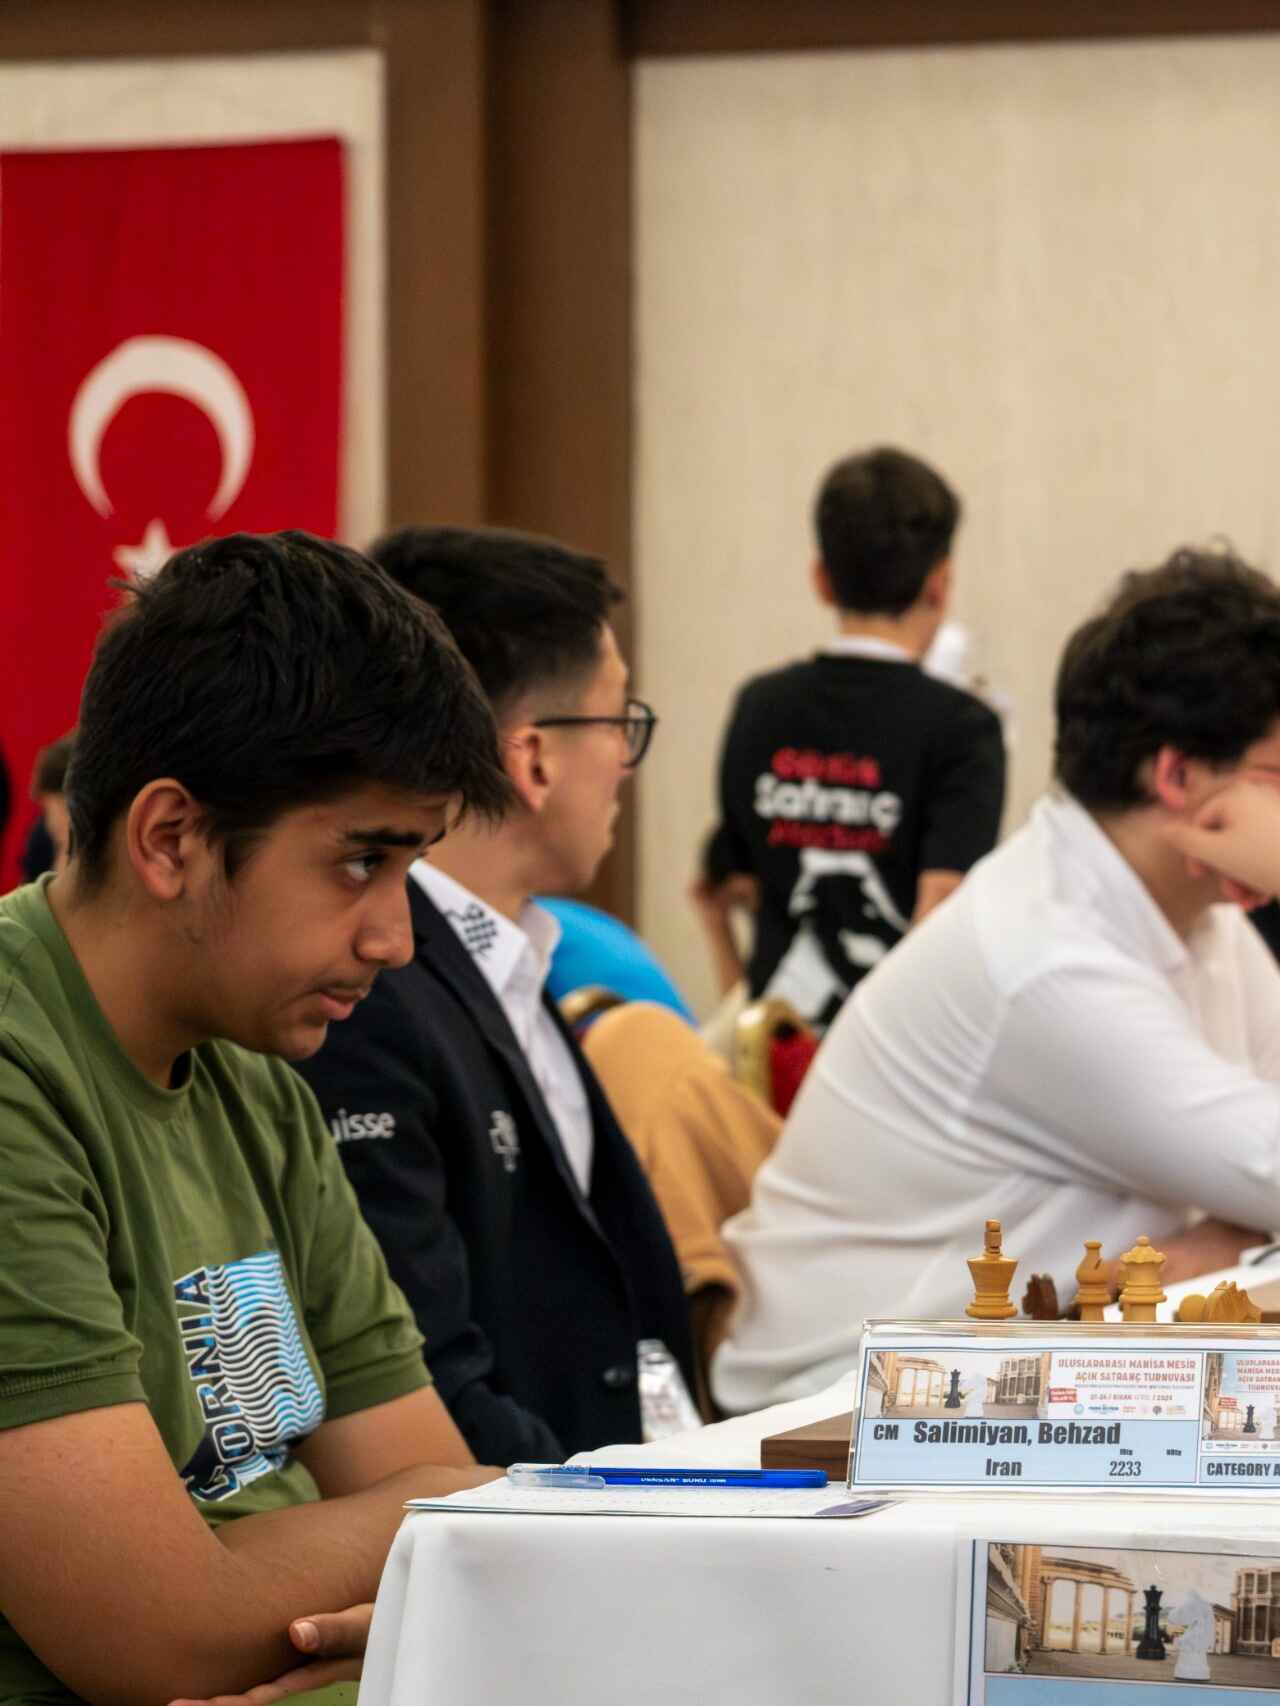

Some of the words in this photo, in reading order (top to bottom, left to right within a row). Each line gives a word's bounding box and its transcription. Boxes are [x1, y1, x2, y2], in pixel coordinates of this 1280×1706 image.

[873, 1425, 899, 1441] CM
[913, 1421, 1032, 1446] Salimiyan,
[1038, 1422, 1121, 1445] Behzad
[985, 1458, 1022, 1477] Iran
[1109, 1461, 1142, 1477] 2233
[1207, 1462, 1271, 1477] CATEGORY
